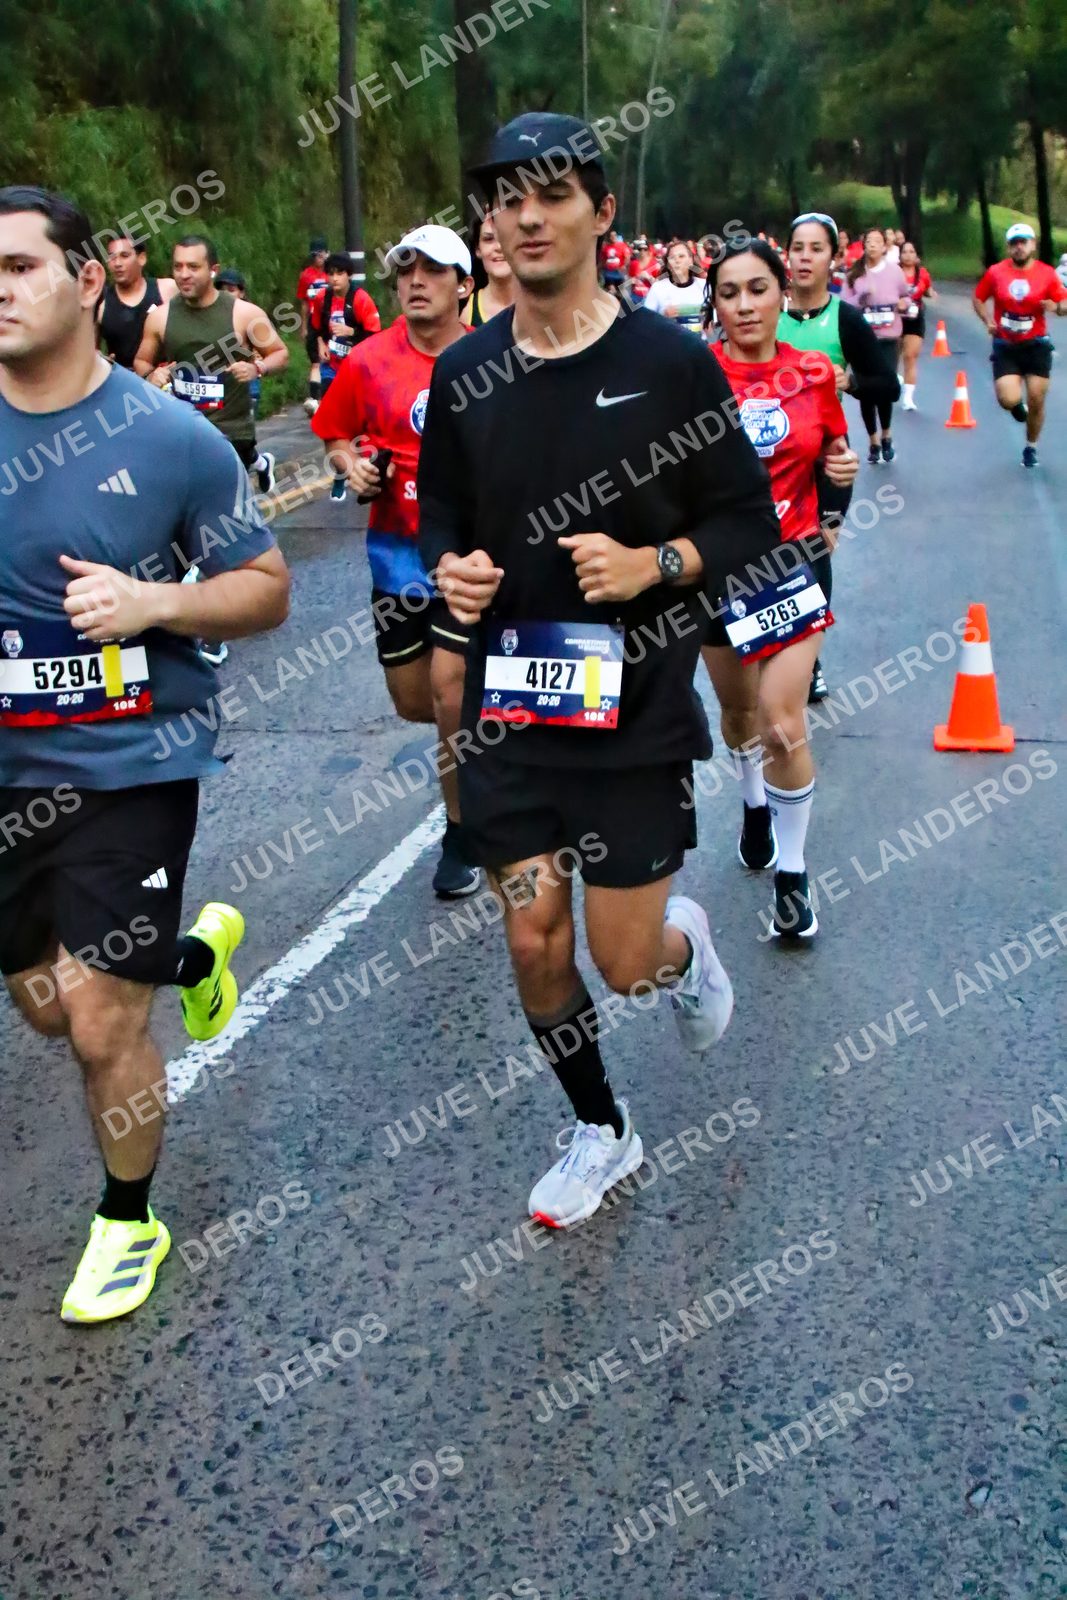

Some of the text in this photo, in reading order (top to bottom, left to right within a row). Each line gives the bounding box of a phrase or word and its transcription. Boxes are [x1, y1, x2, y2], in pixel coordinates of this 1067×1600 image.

[404, 480, 417, 500] S
[755, 598, 801, 631] 5263
[33, 656, 102, 690] 5294
[526, 661, 576, 690] 4127
[113, 699, 137, 711] 10K
[584, 711, 606, 721] 10K
